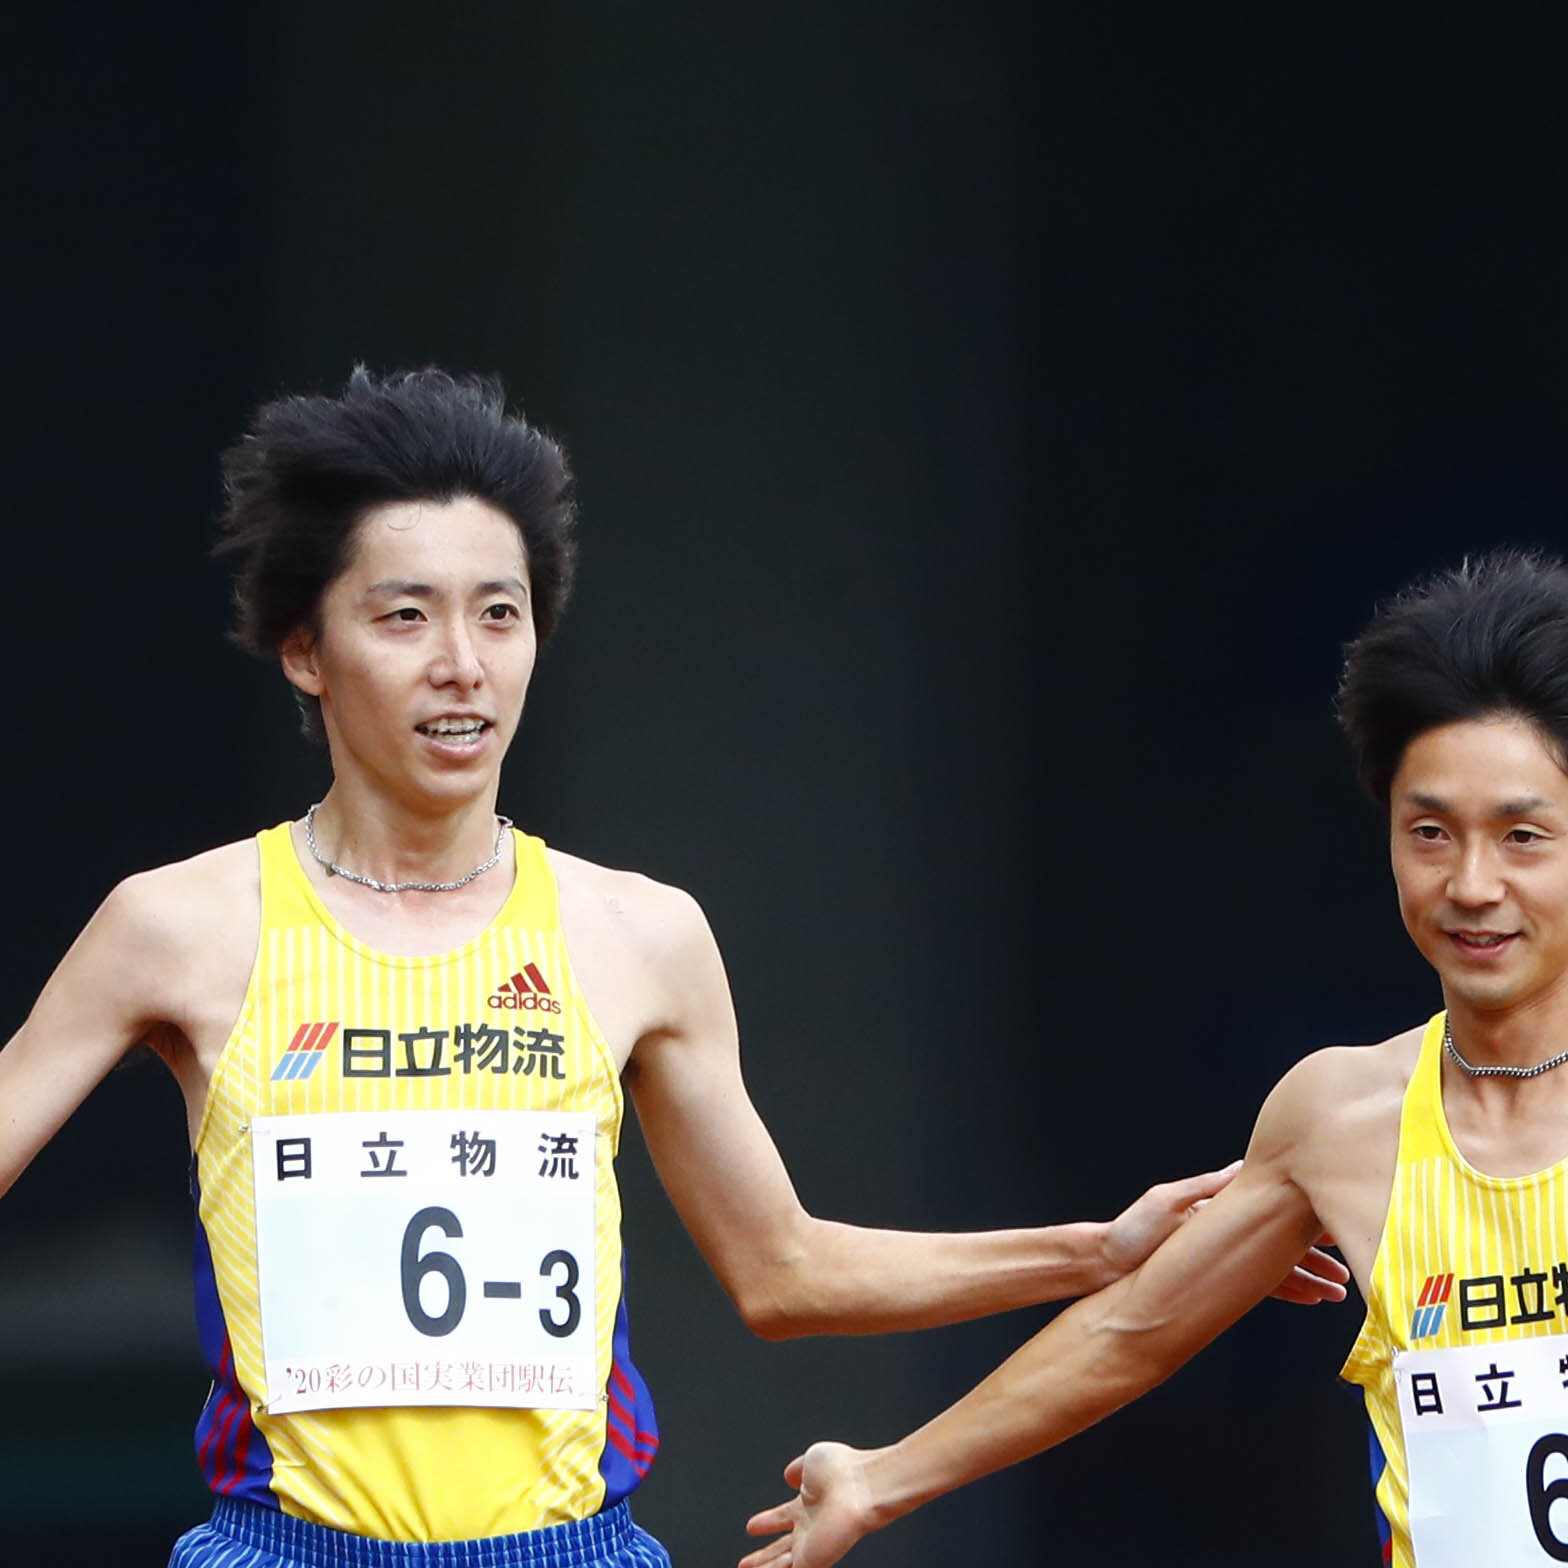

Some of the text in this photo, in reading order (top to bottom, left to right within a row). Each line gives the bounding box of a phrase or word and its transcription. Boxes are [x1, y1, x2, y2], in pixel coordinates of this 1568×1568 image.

[487, 993, 562, 1015] adidas
[343, 1022, 566, 1080] 日立物流
[275, 1131, 579, 1181] 日立物流
[400, 1206, 582, 1338] 6-3
